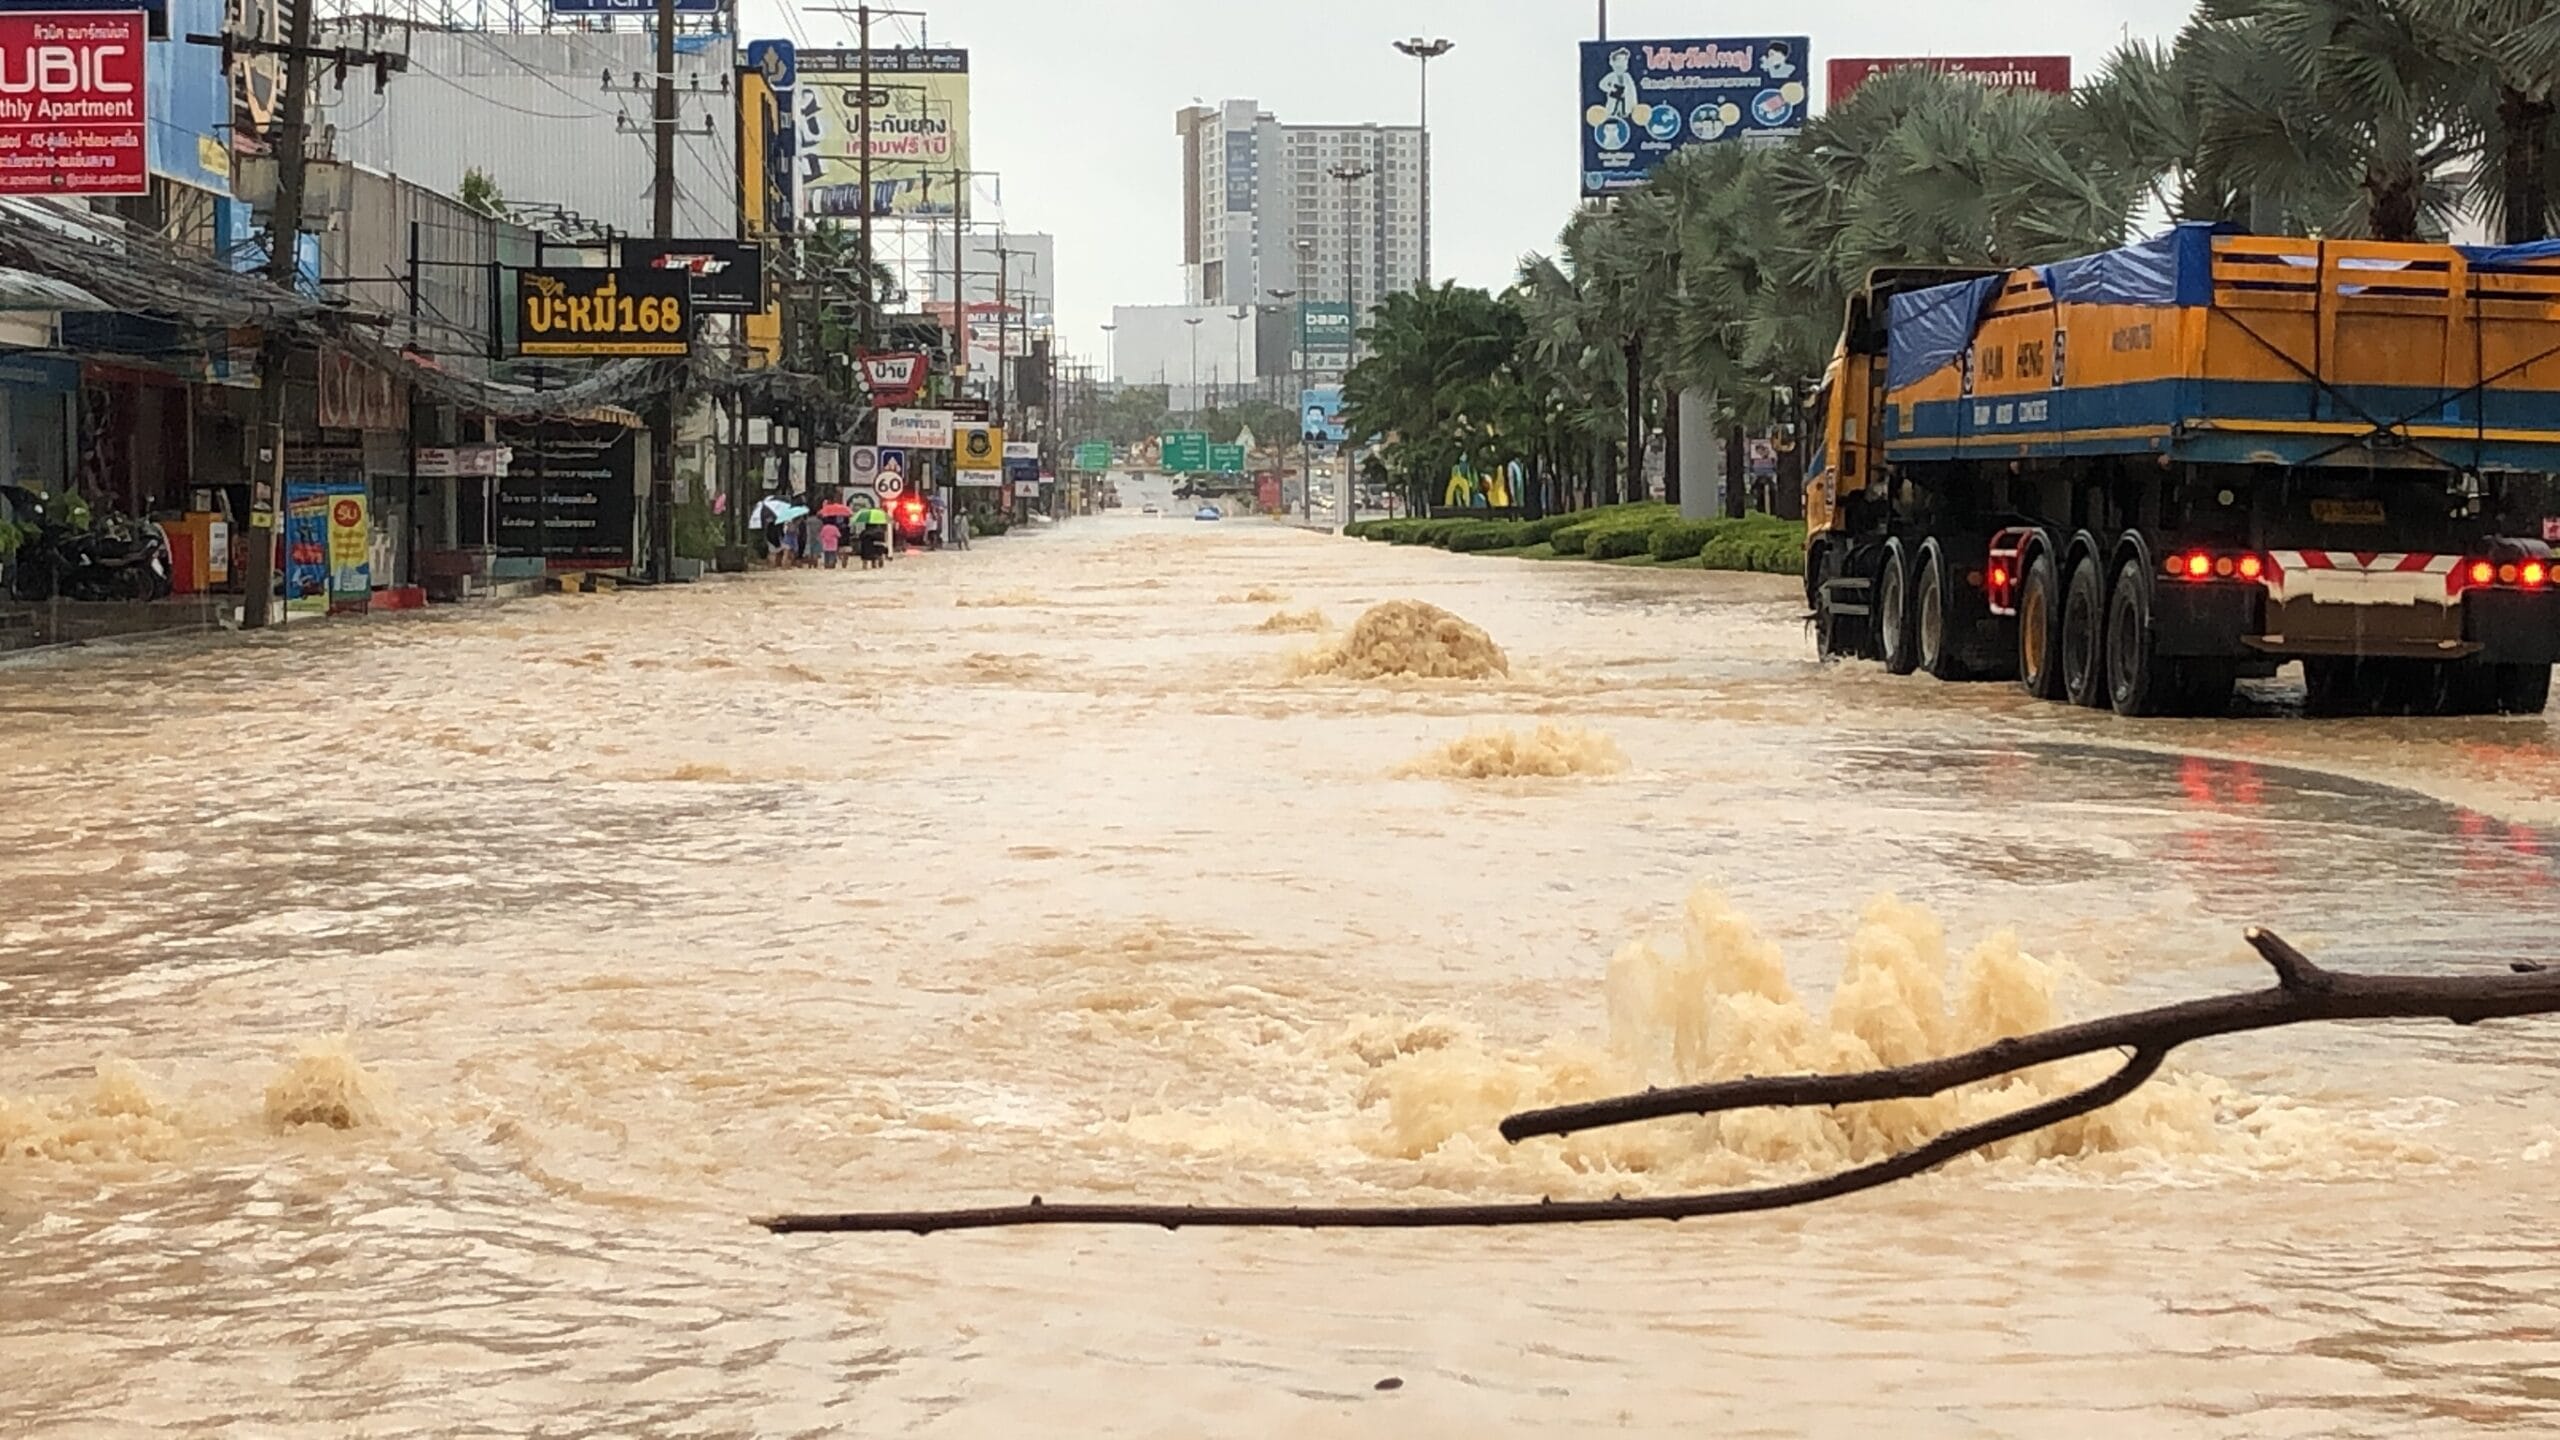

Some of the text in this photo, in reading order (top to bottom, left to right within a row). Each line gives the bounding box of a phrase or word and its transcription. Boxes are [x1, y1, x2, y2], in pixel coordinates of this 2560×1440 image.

[0, 46, 133, 92] UBIC
[38, 98, 134, 121] Apartment
[527, 272, 681, 333] บะหมี่168
[1306, 312, 1349, 325] baan
[878, 478, 901, 492] 60
